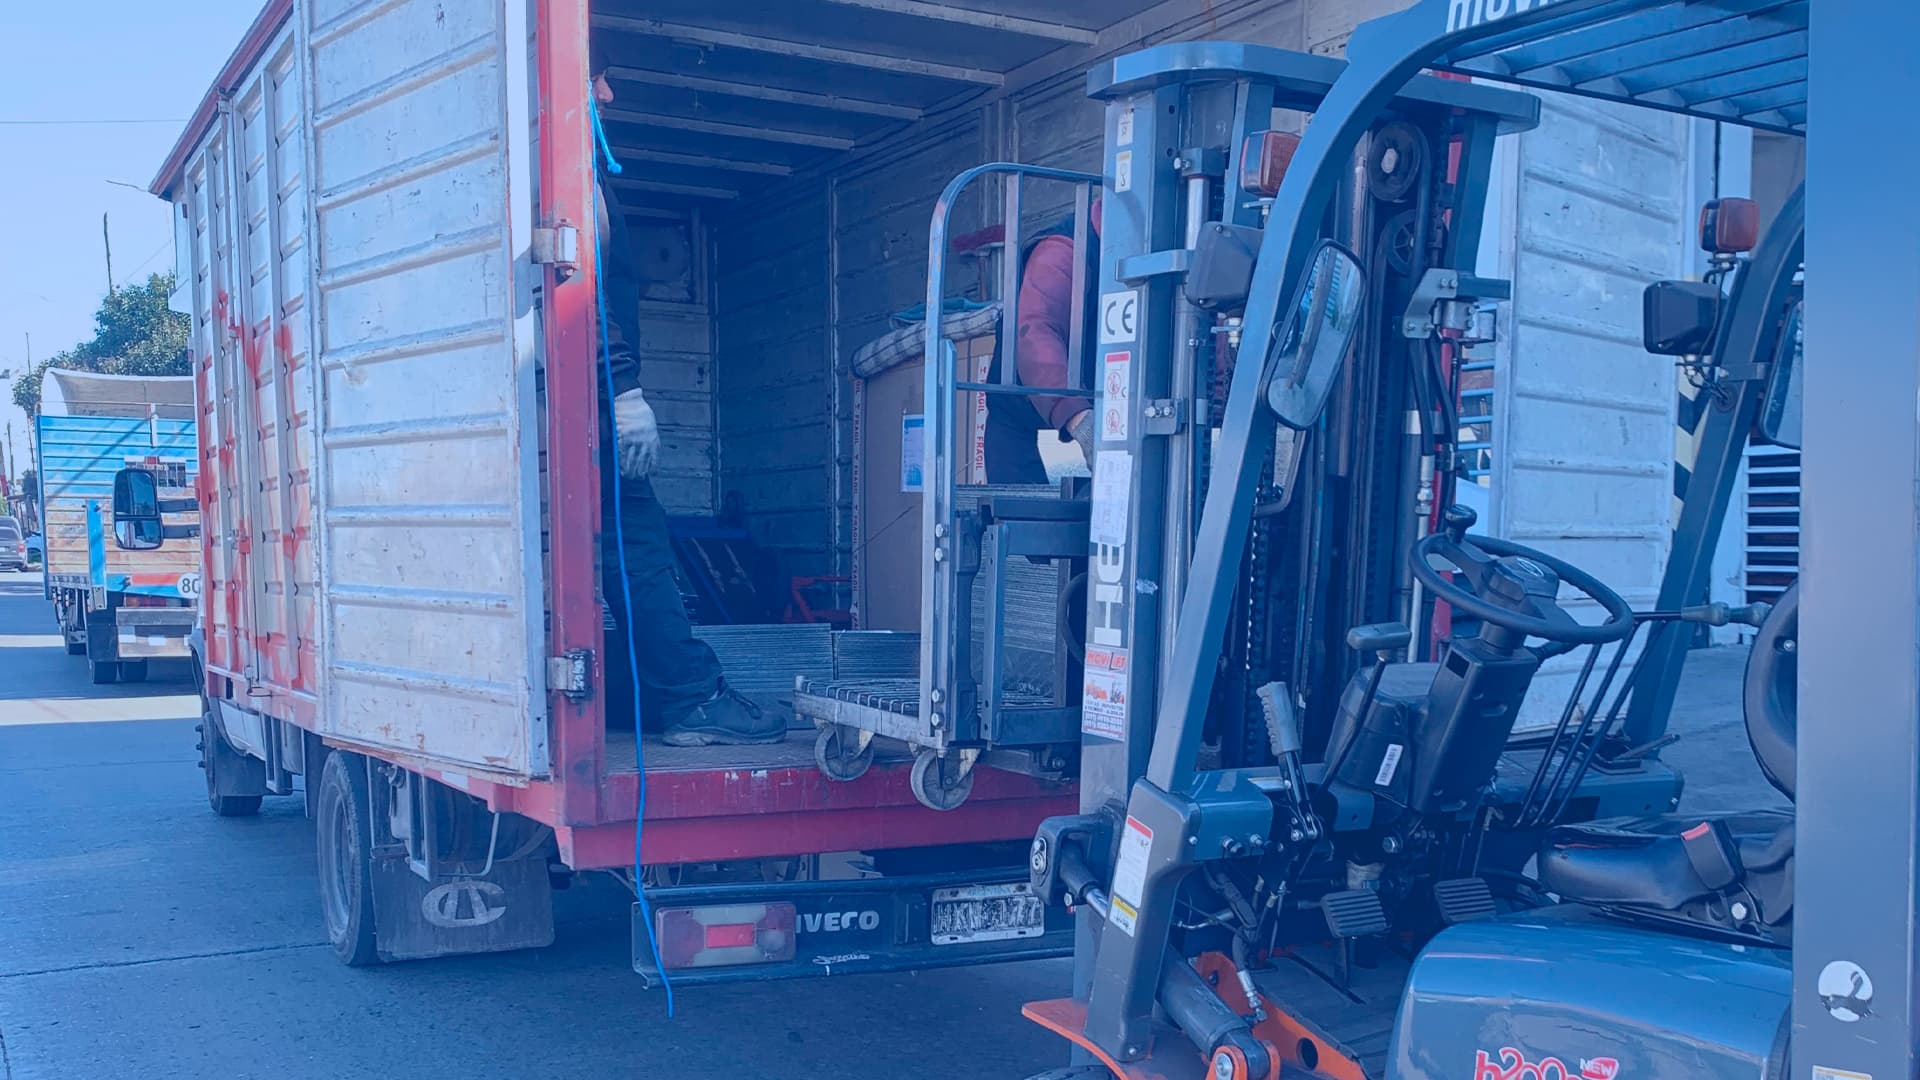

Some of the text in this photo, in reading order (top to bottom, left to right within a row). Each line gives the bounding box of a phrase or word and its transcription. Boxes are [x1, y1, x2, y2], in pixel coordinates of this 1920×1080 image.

[1105, 298, 1134, 336] CE
[977, 379, 985, 414] FAGIL
[976, 436, 985, 471] FRAGIL
[795, 910, 880, 934] IVECO
[1579, 1057, 1613, 1076] NEW
